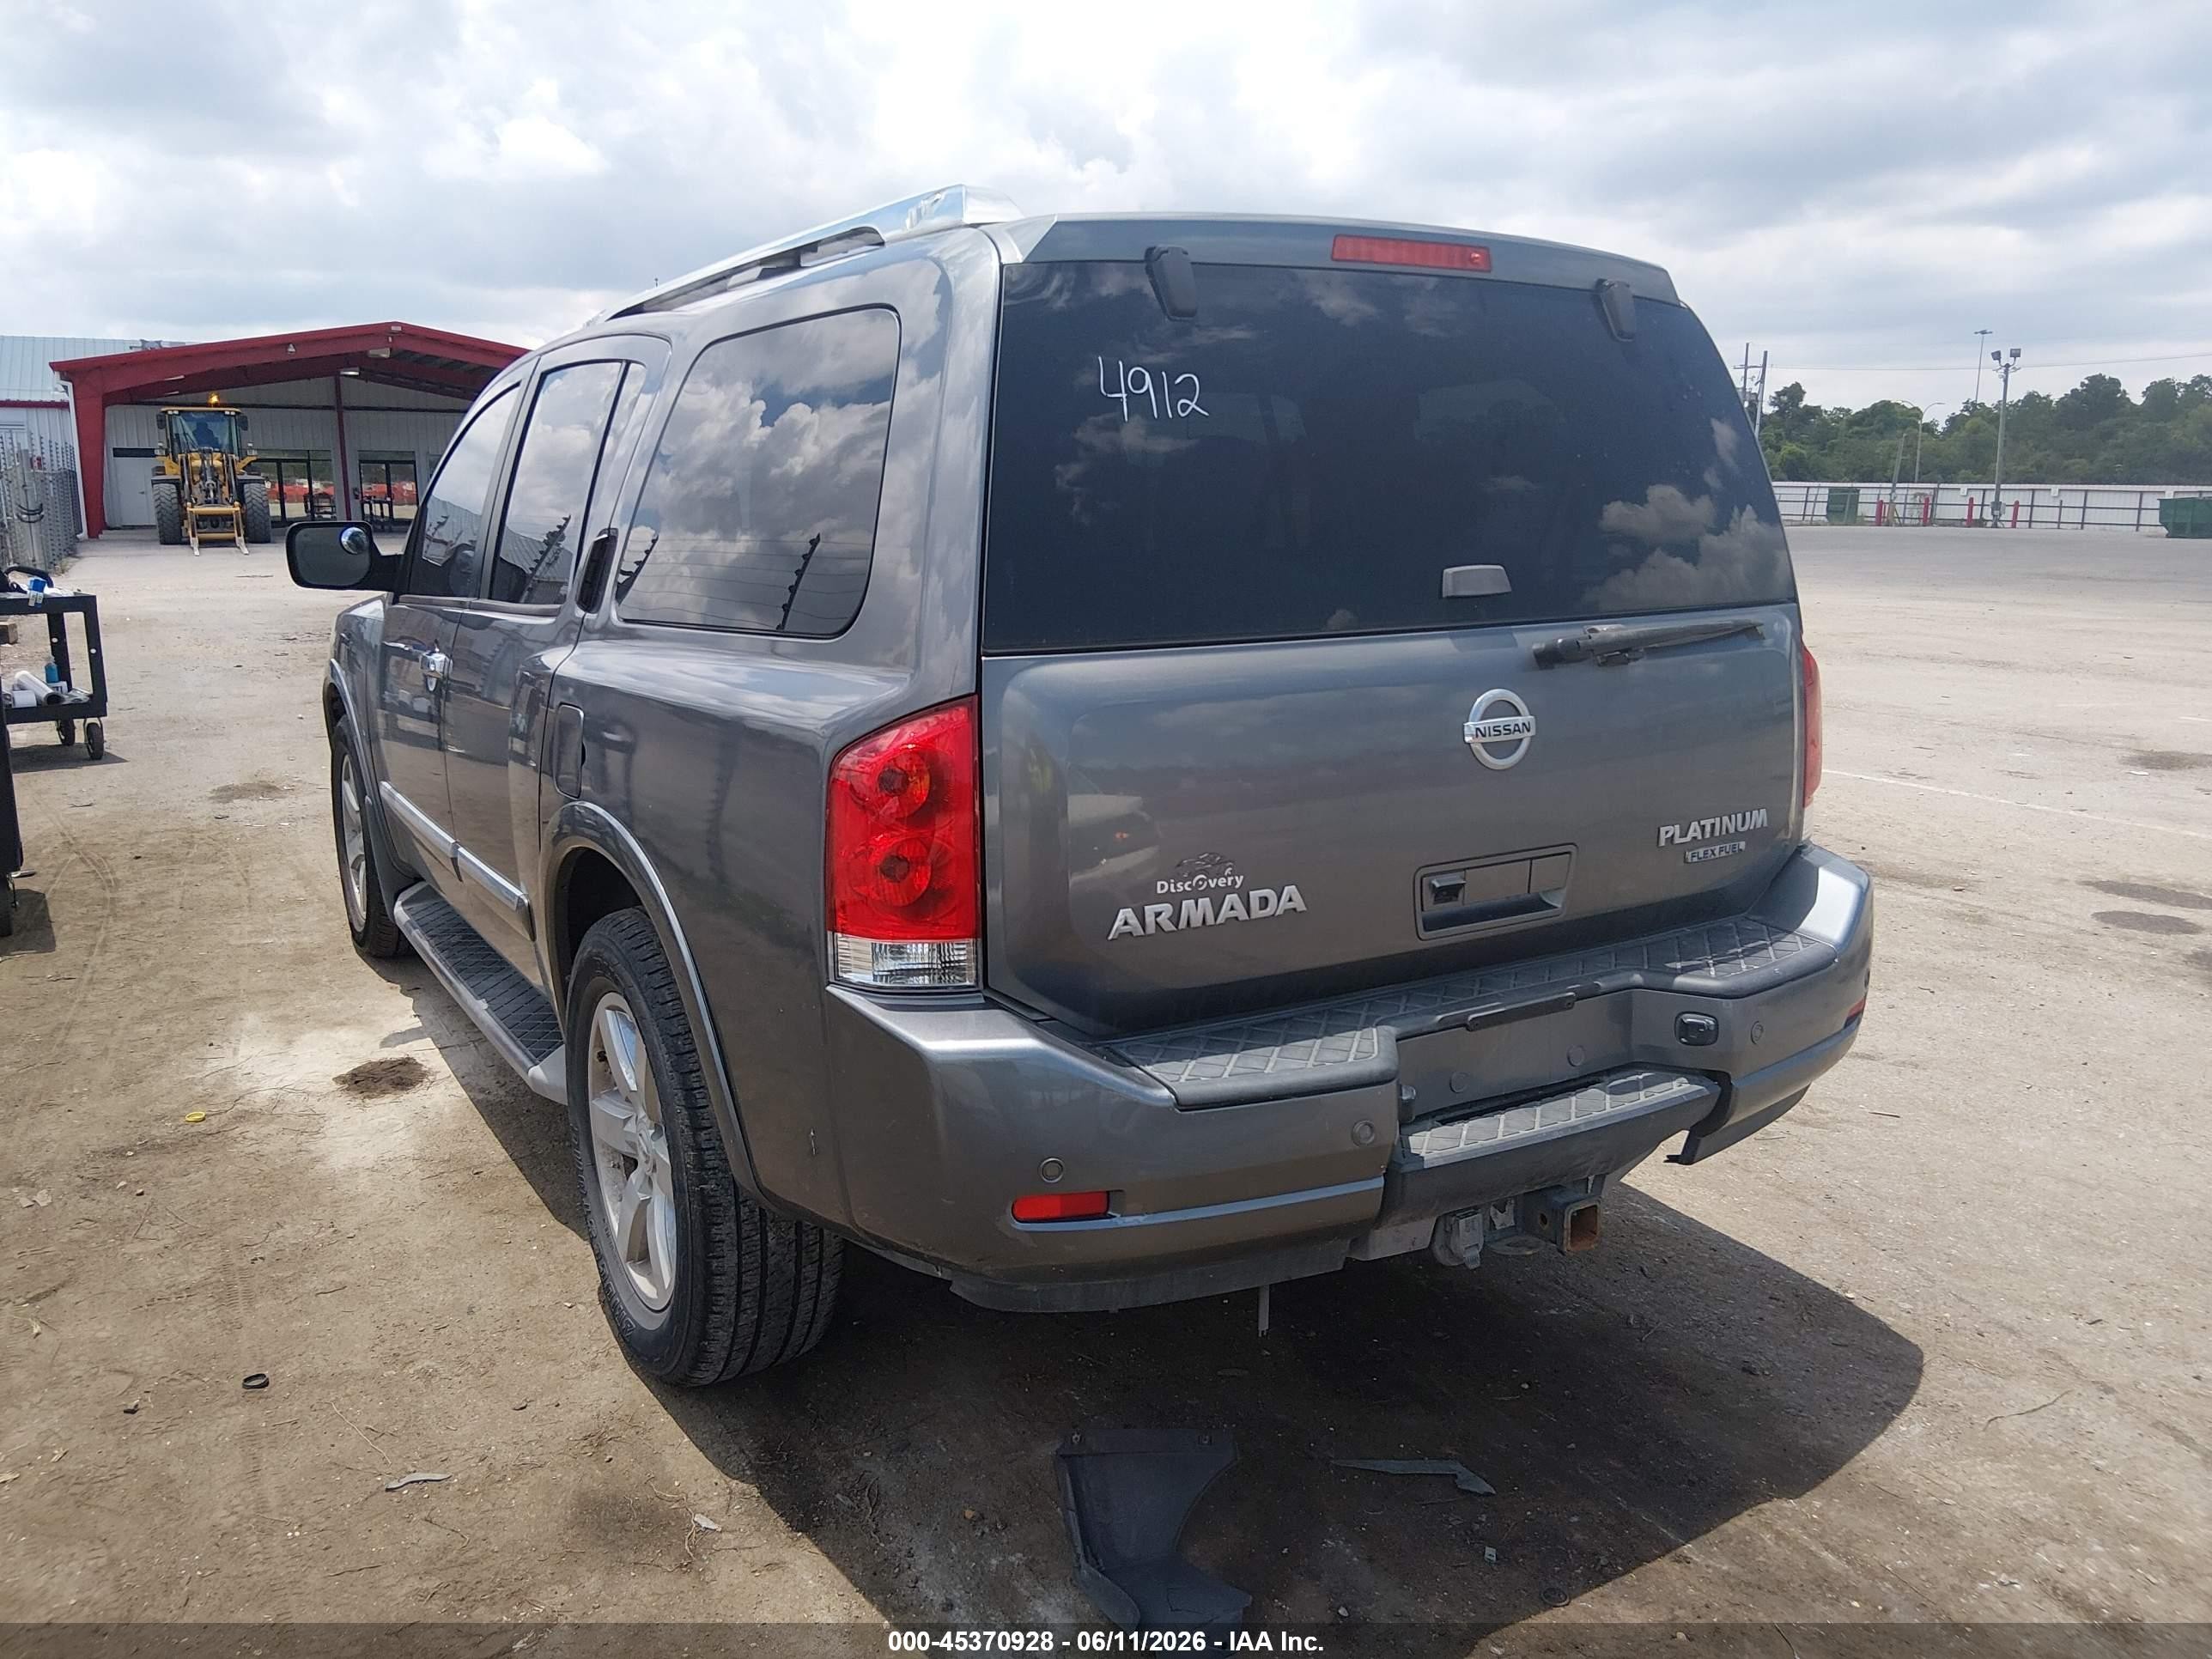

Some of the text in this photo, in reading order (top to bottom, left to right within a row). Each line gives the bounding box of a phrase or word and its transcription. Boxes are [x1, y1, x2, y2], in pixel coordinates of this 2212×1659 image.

[1098, 356, 1210, 422] 4912
[1475, 721, 1531, 738] NISSAN
[1658, 809, 1768, 847] PLATINUM
[1690, 842, 1744, 861] FLEX FUEL
[1156, 874, 1244, 895] Discovery
[1108, 884, 1308, 941] ARMADA
